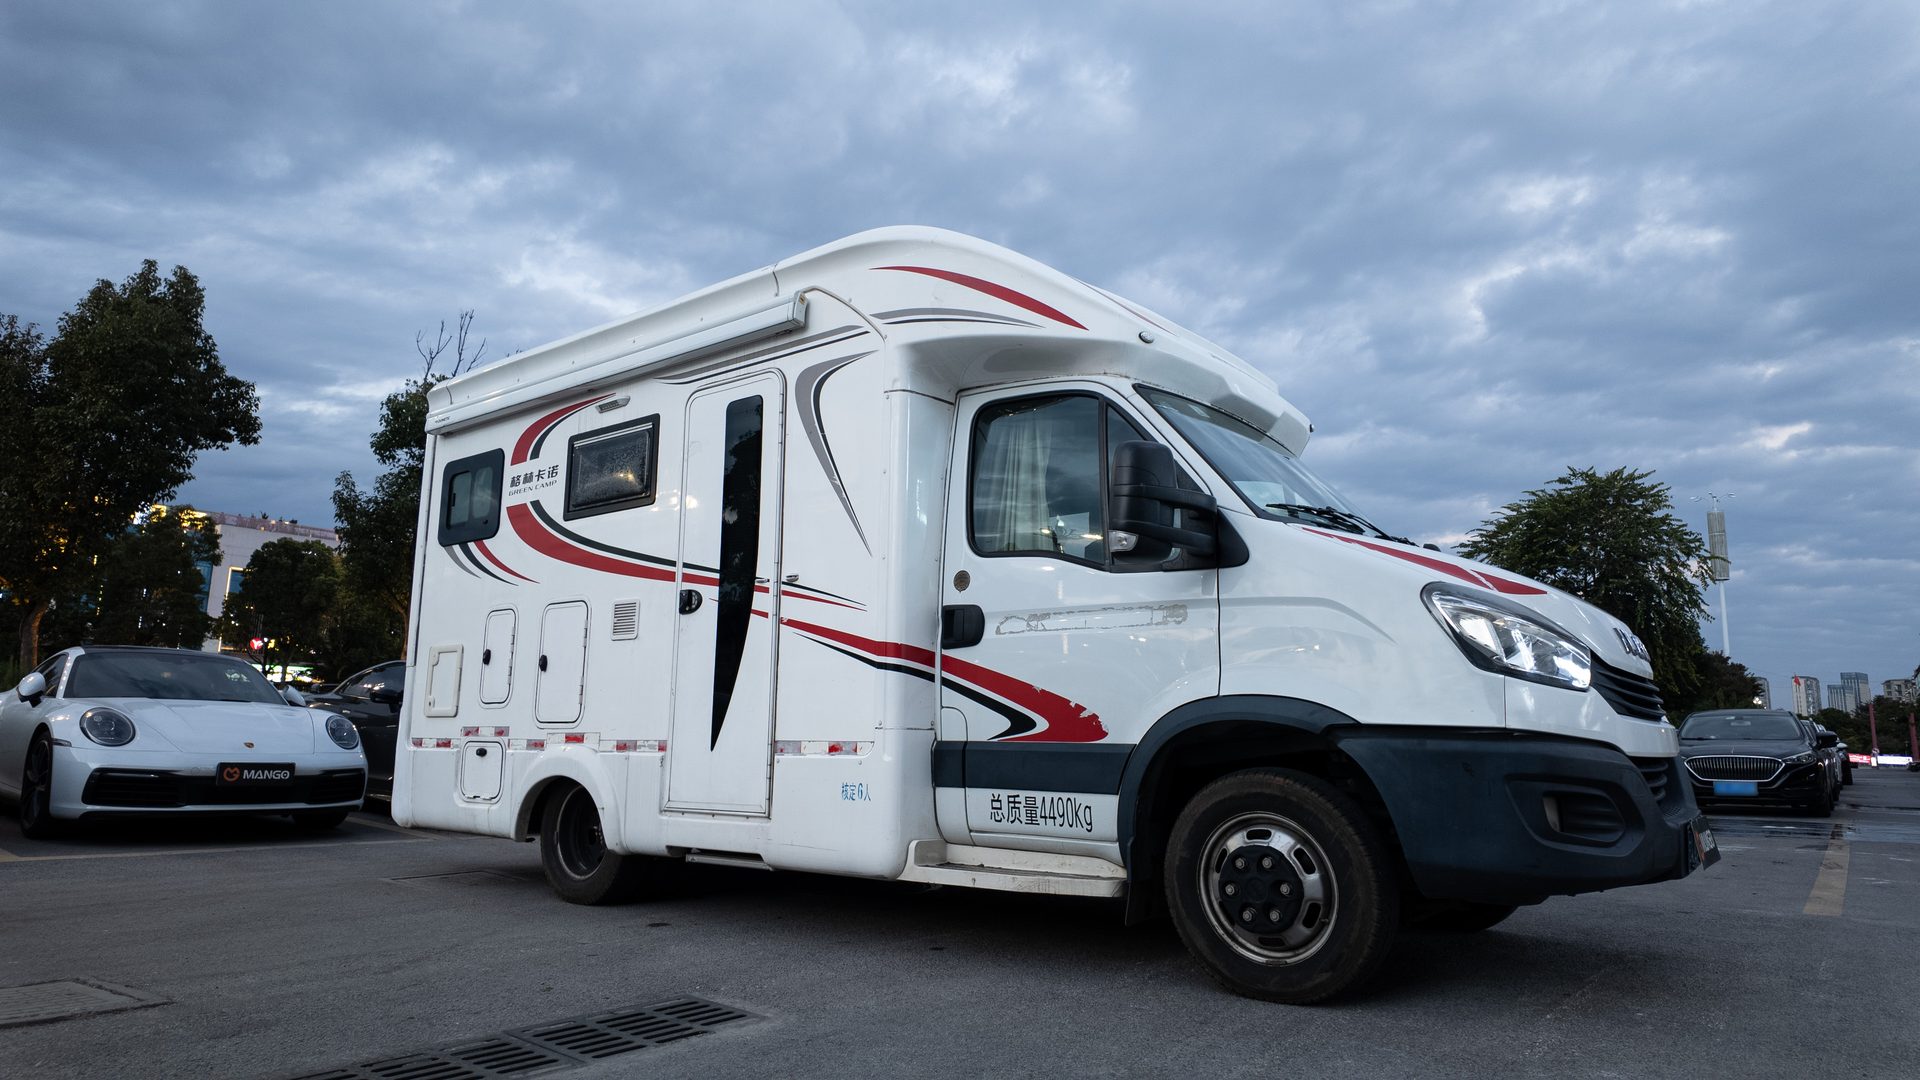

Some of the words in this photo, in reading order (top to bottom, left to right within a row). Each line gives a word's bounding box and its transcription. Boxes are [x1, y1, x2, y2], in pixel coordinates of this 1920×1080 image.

[508, 486, 534, 497] GREEN
[534, 480, 558, 490] CAMP
[243, 769, 290, 780] MANGO
[990, 793, 1093, 832] 总质量4490kg
